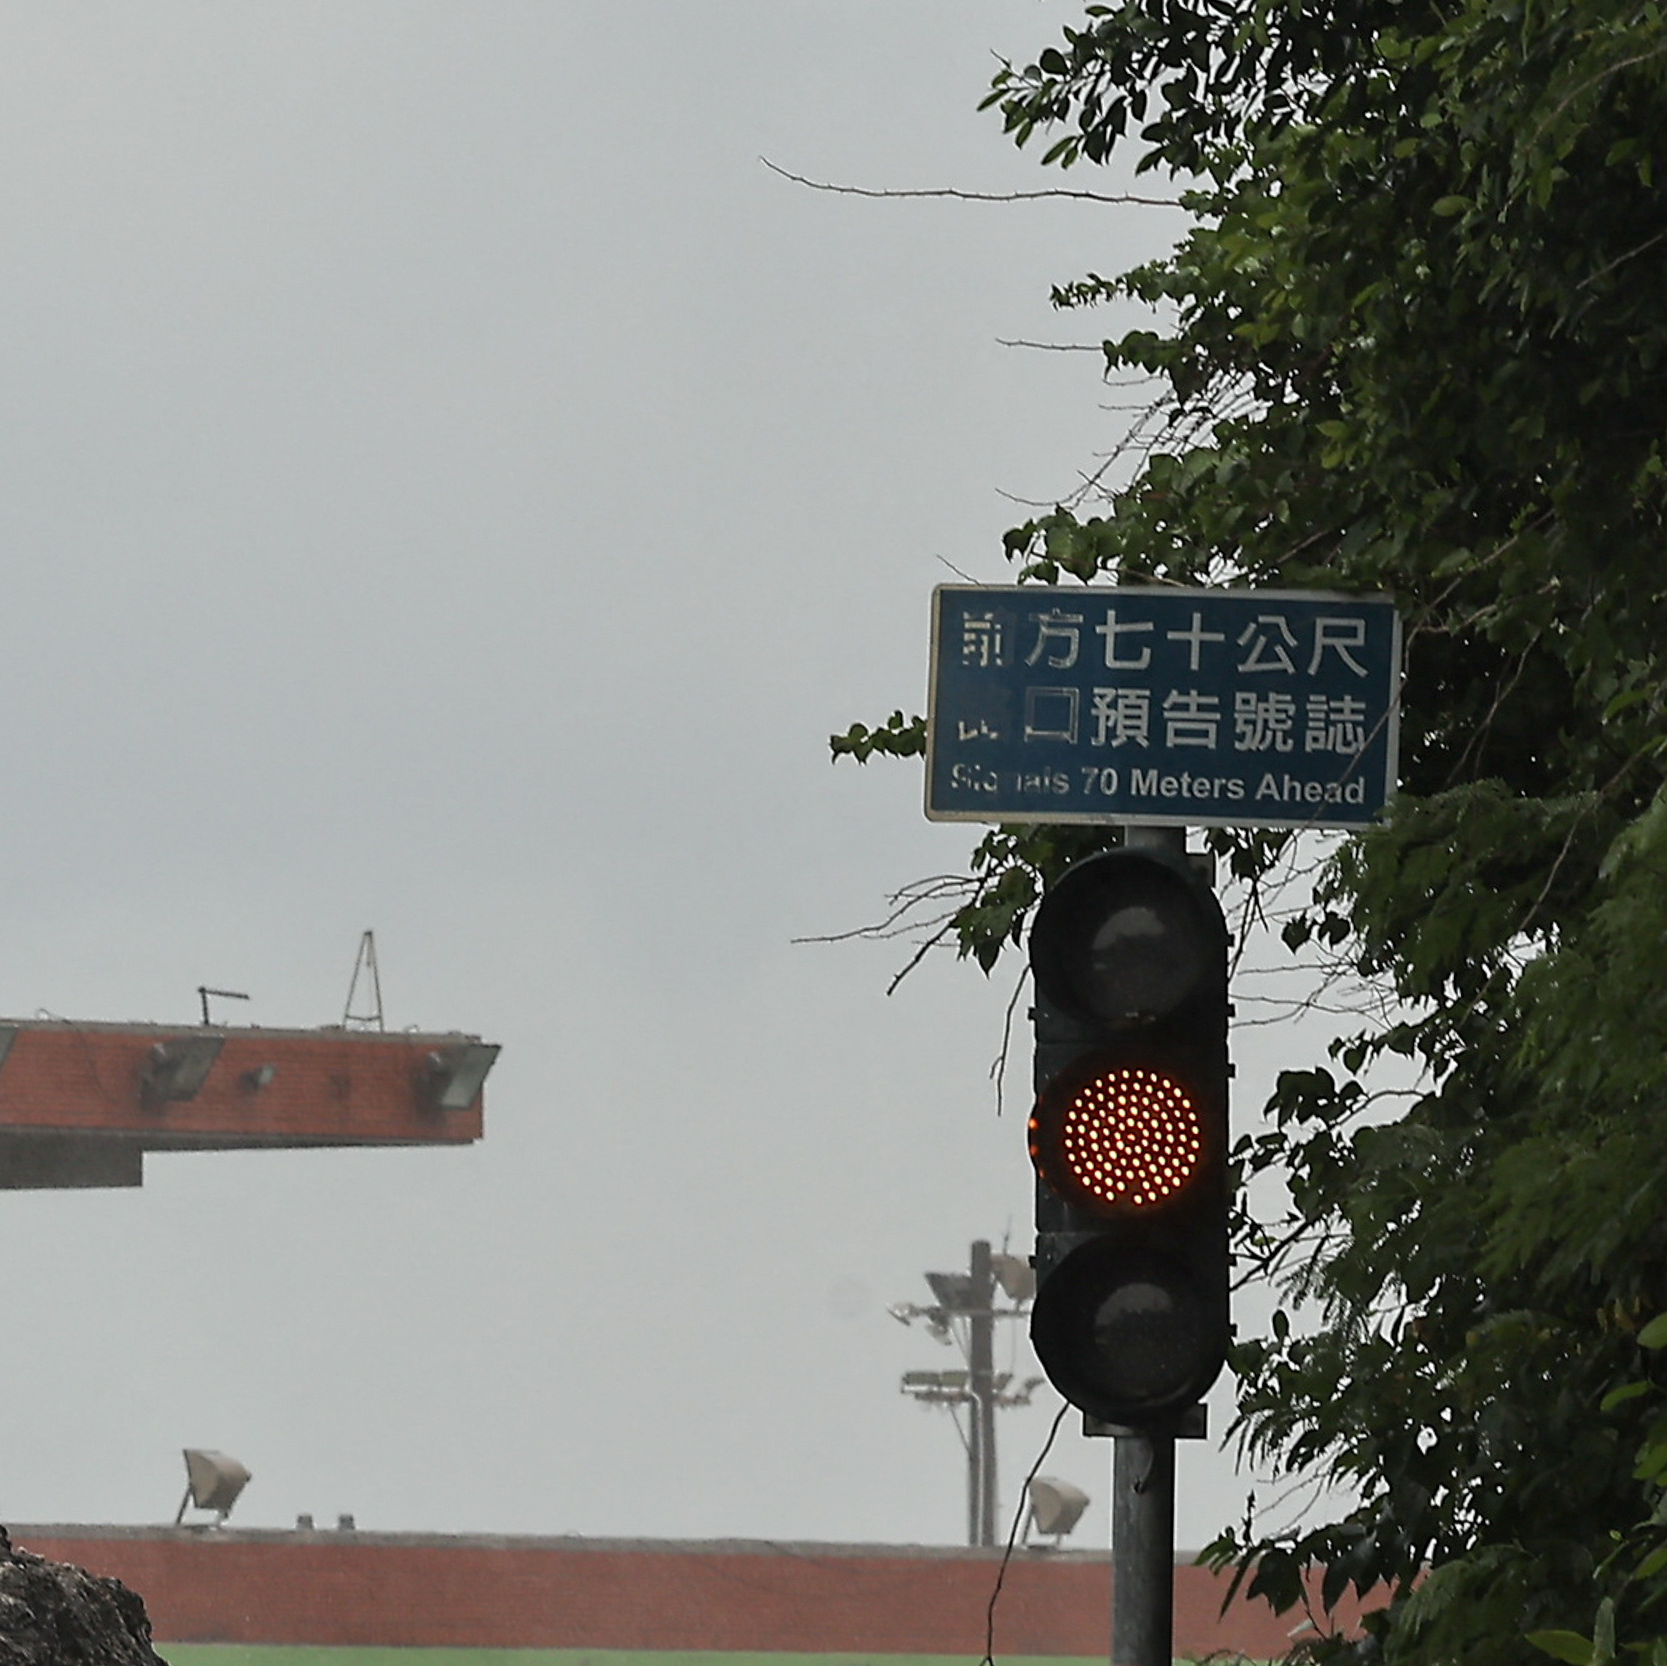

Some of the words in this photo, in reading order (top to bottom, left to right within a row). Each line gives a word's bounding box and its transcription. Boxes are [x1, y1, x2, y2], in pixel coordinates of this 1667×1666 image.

[963, 607, 1368, 677] 前方七十公尺
[958, 686, 1366, 755] 口預告號誌
[1081, 766, 1117, 796] 70
[1130, 768, 1245, 799] Meters
[1255, 773, 1364, 804] Ahead
